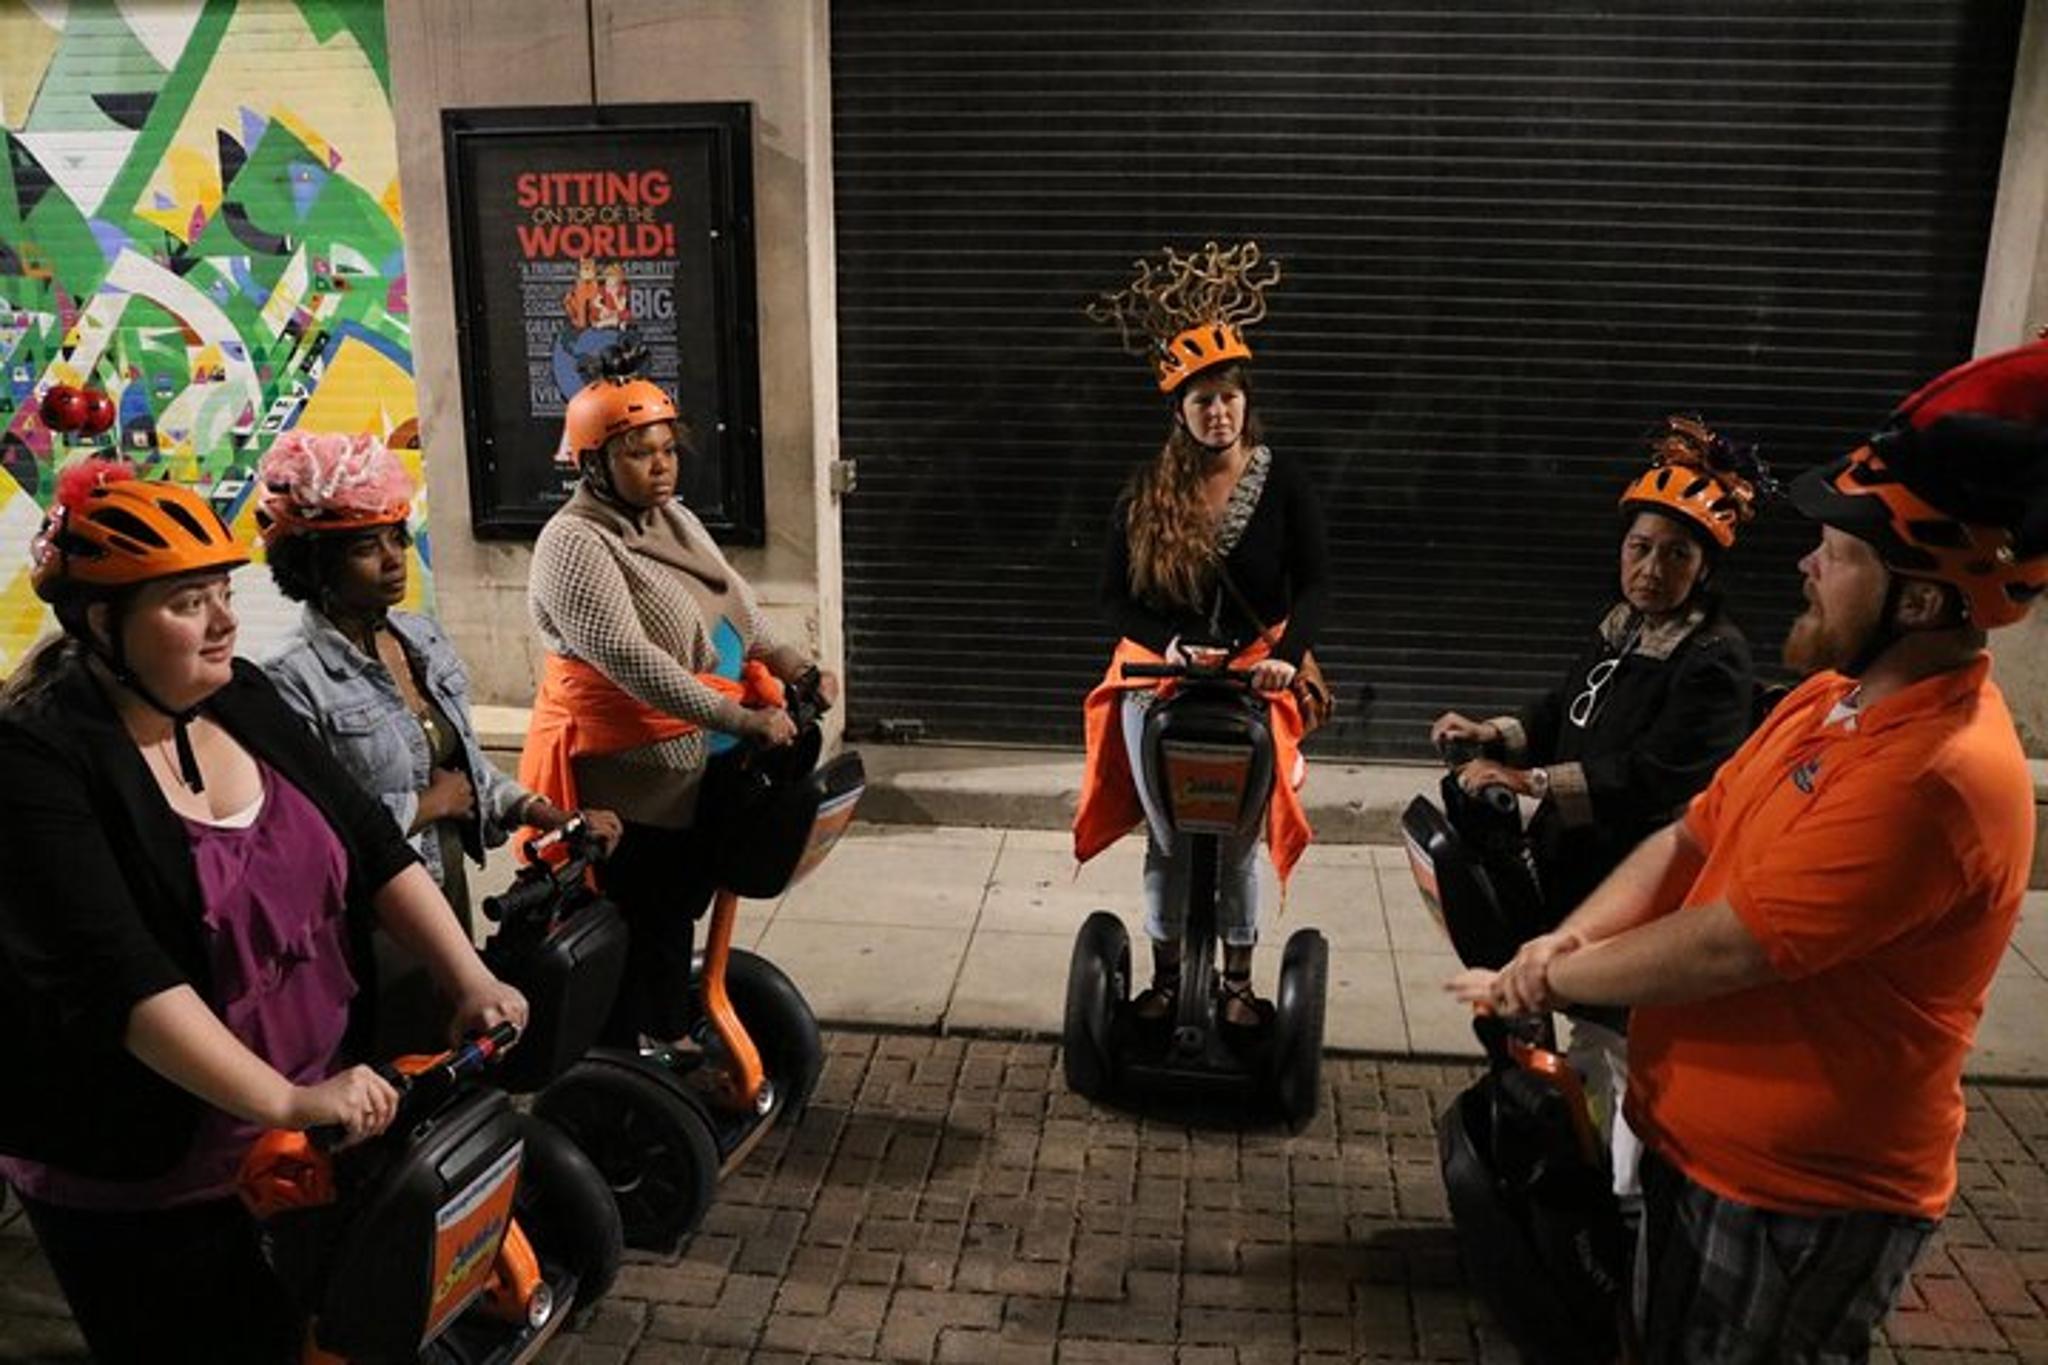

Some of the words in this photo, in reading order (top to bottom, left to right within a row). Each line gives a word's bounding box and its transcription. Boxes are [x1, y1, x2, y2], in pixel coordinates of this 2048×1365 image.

[516, 170, 672, 207] SITTING
[531, 207, 562, 223] ON
[567, 207, 595, 222] TOP
[600, 207, 624, 222] OF
[628, 207, 656, 222] THE
[516, 222, 675, 259] WORLD!
